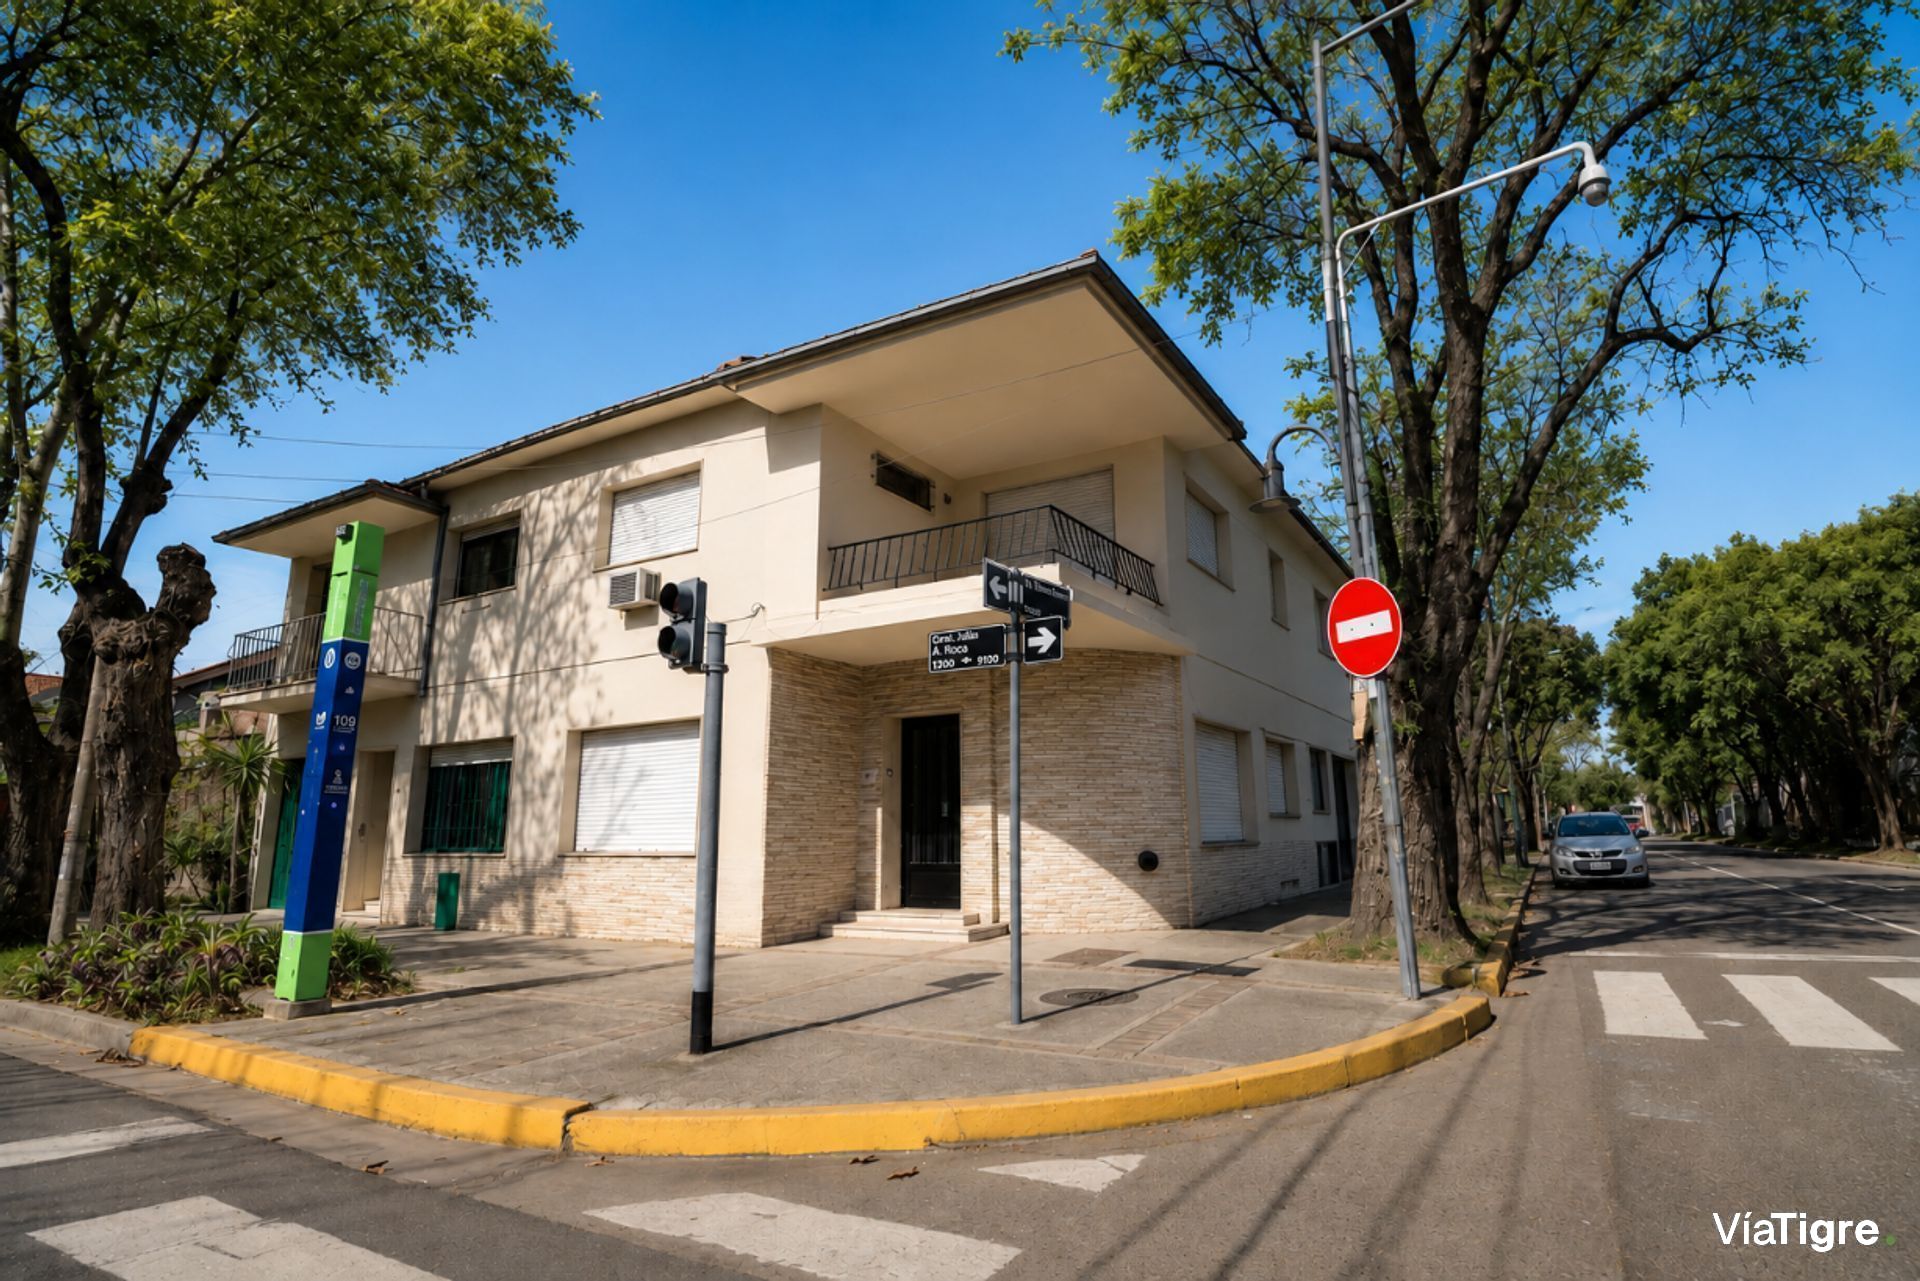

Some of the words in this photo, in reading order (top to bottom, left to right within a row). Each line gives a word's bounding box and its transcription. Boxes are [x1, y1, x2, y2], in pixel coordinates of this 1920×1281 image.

[944, 644, 968, 655] Roca
[977, 654, 999, 666] 9100
[333, 715, 356, 727] 109
